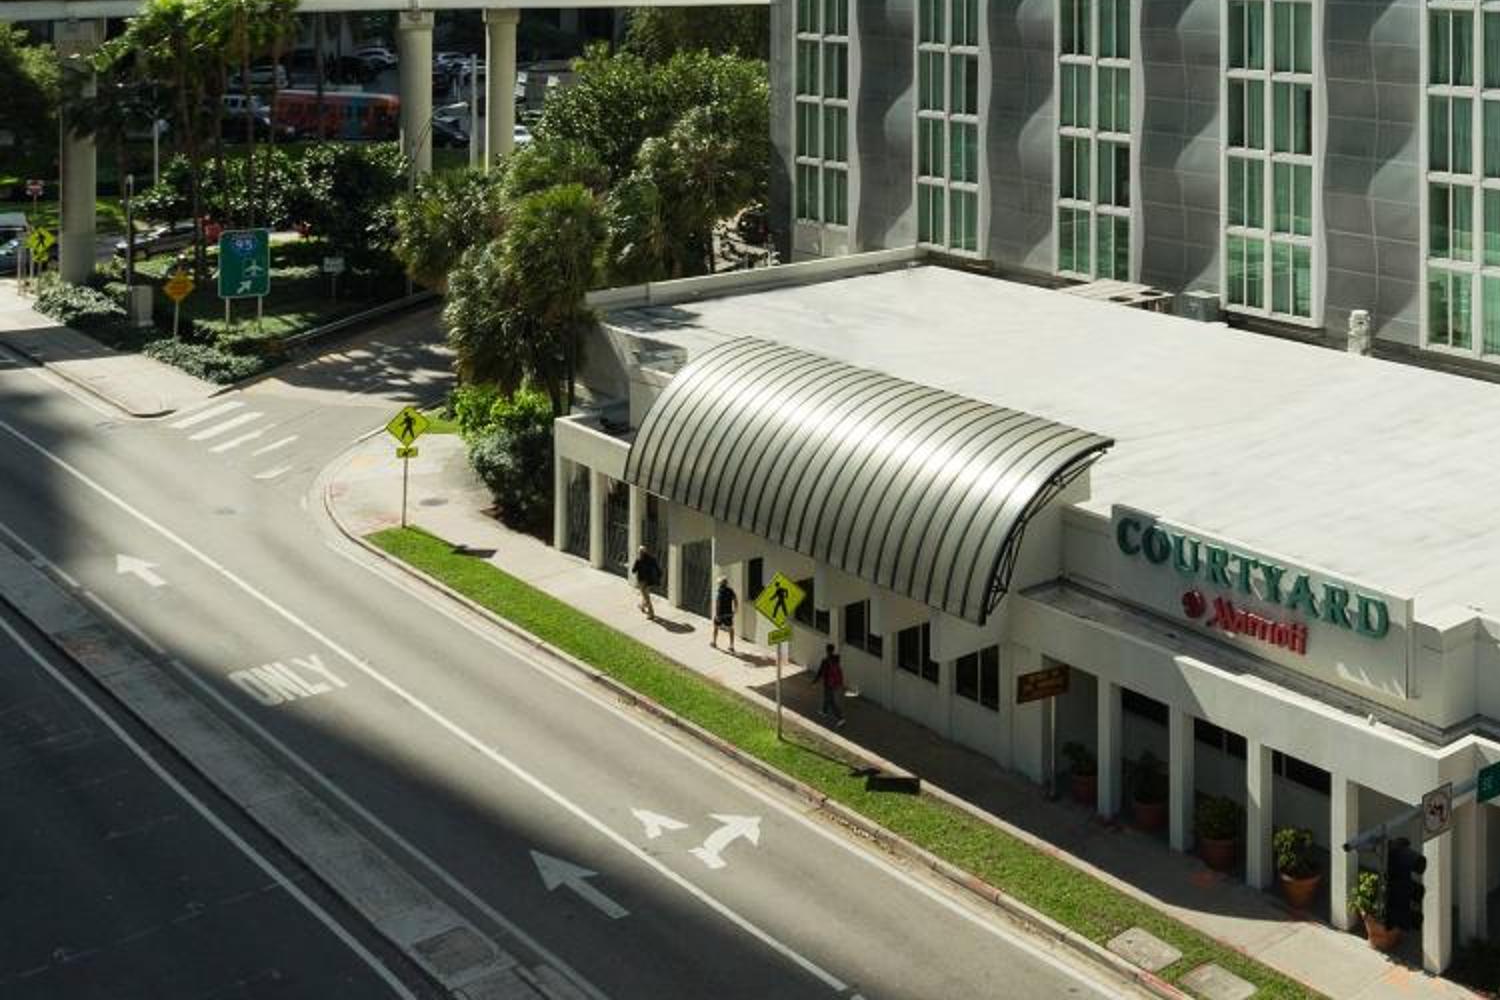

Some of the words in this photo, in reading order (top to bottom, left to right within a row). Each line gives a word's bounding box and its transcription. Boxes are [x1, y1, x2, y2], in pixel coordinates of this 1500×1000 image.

[1116, 517, 1391, 640] COURTYARD
[1206, 596, 1308, 655] Marriott
[228, 653, 348, 706] ONLY
